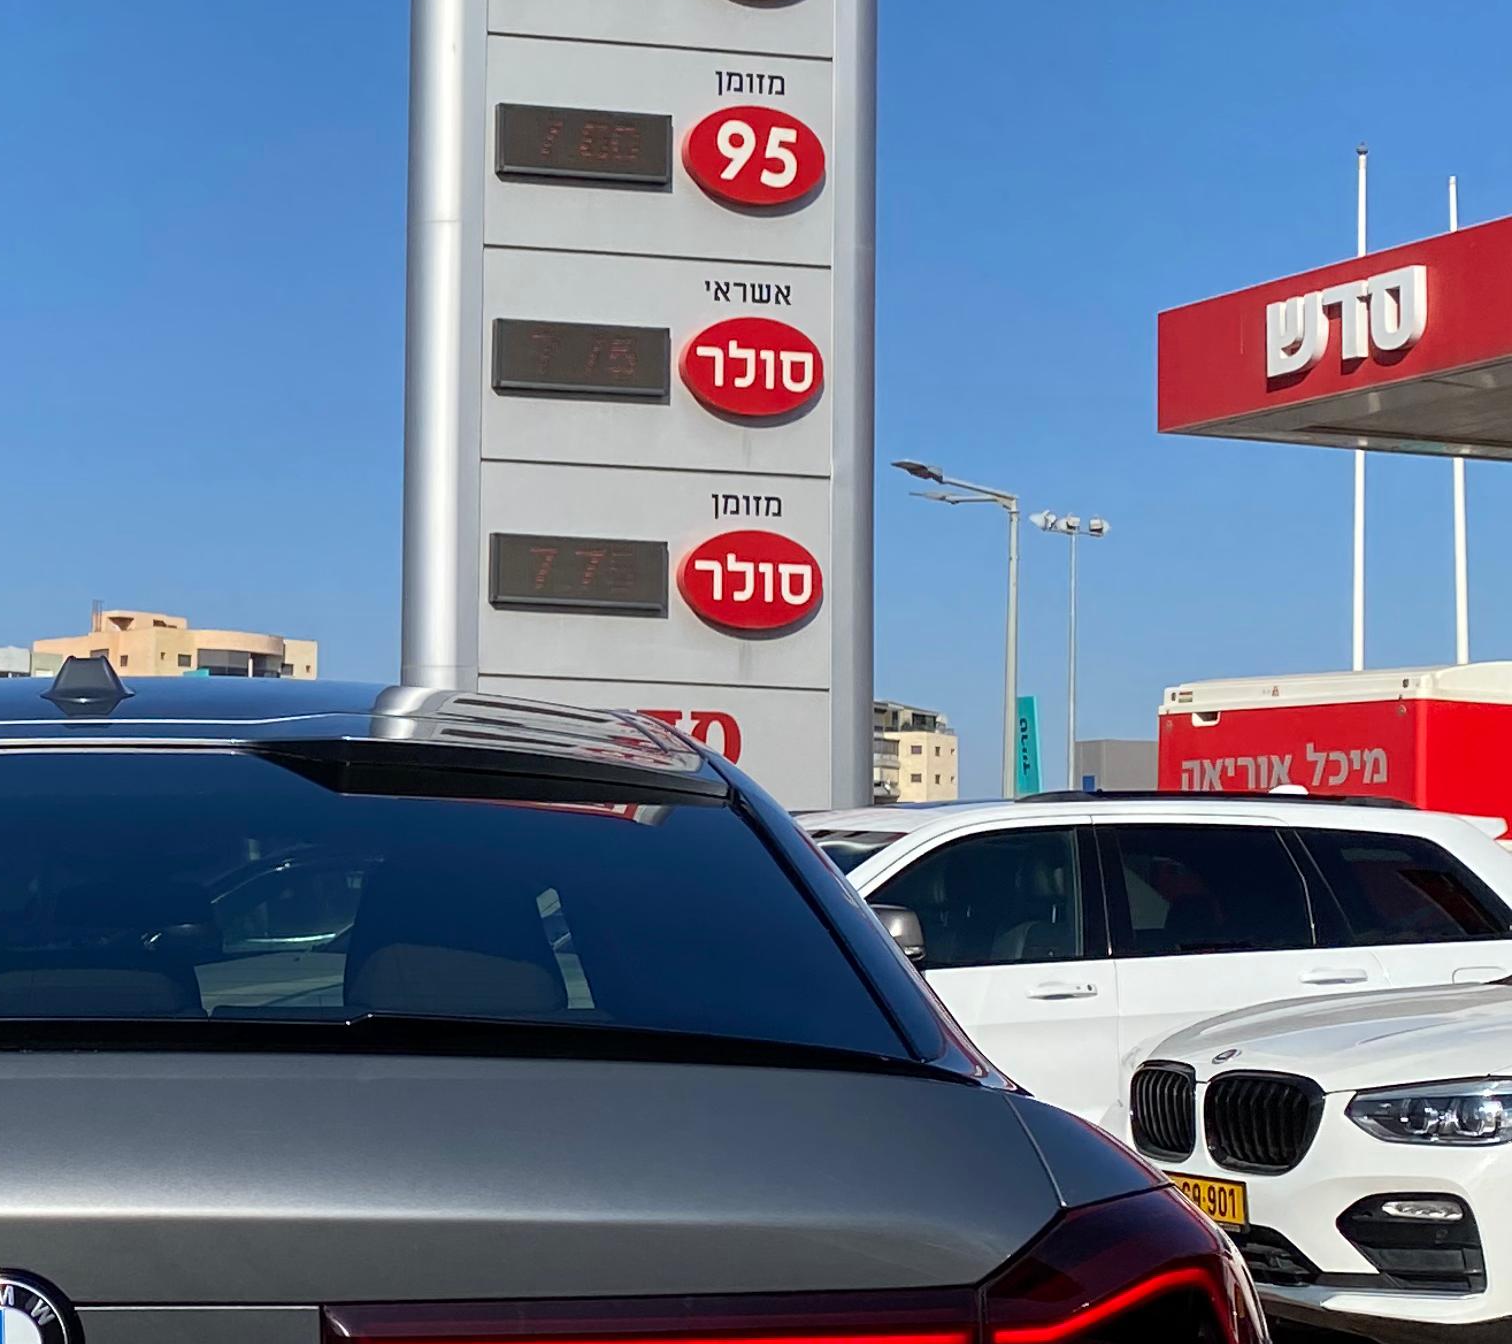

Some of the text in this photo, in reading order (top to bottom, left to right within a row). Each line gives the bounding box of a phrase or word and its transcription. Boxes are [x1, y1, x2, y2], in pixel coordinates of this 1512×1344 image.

[715, 71, 785, 96] מזומן
[716, 120, 798, 188] 95
[704, 280, 792, 306] אשראי
[1266, 265, 1427, 379] סדש
[696, 340, 813, 393] סולר
[711, 493, 782, 519] מזומן
[694, 553, 812, 605] סולר
[1181, 742, 1387, 792] מיכל אוריאה
